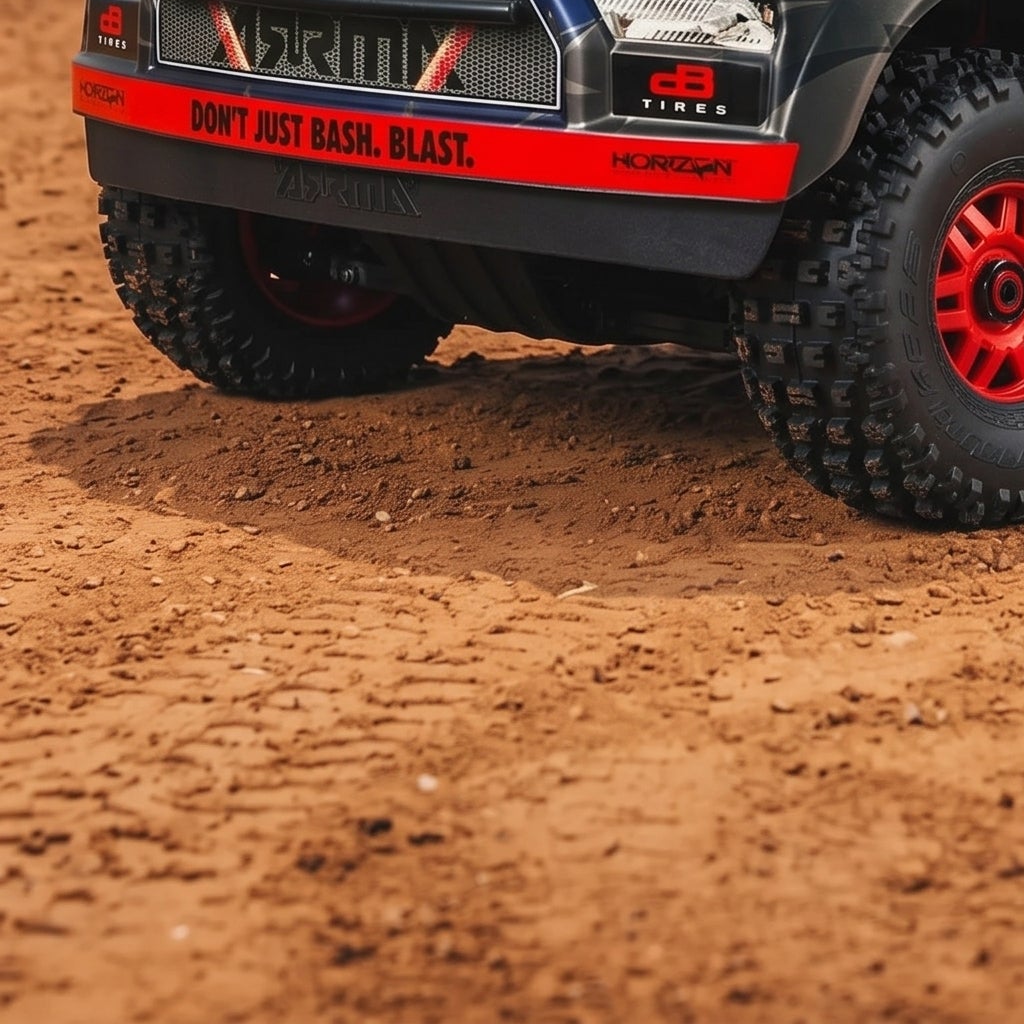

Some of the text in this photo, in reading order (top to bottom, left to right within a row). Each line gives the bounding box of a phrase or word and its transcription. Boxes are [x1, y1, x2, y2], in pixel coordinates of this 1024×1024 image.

[641, 98, 728, 115] TIRES
[191, 99, 475, 168] DON'T JUST BASH. BLAST.
